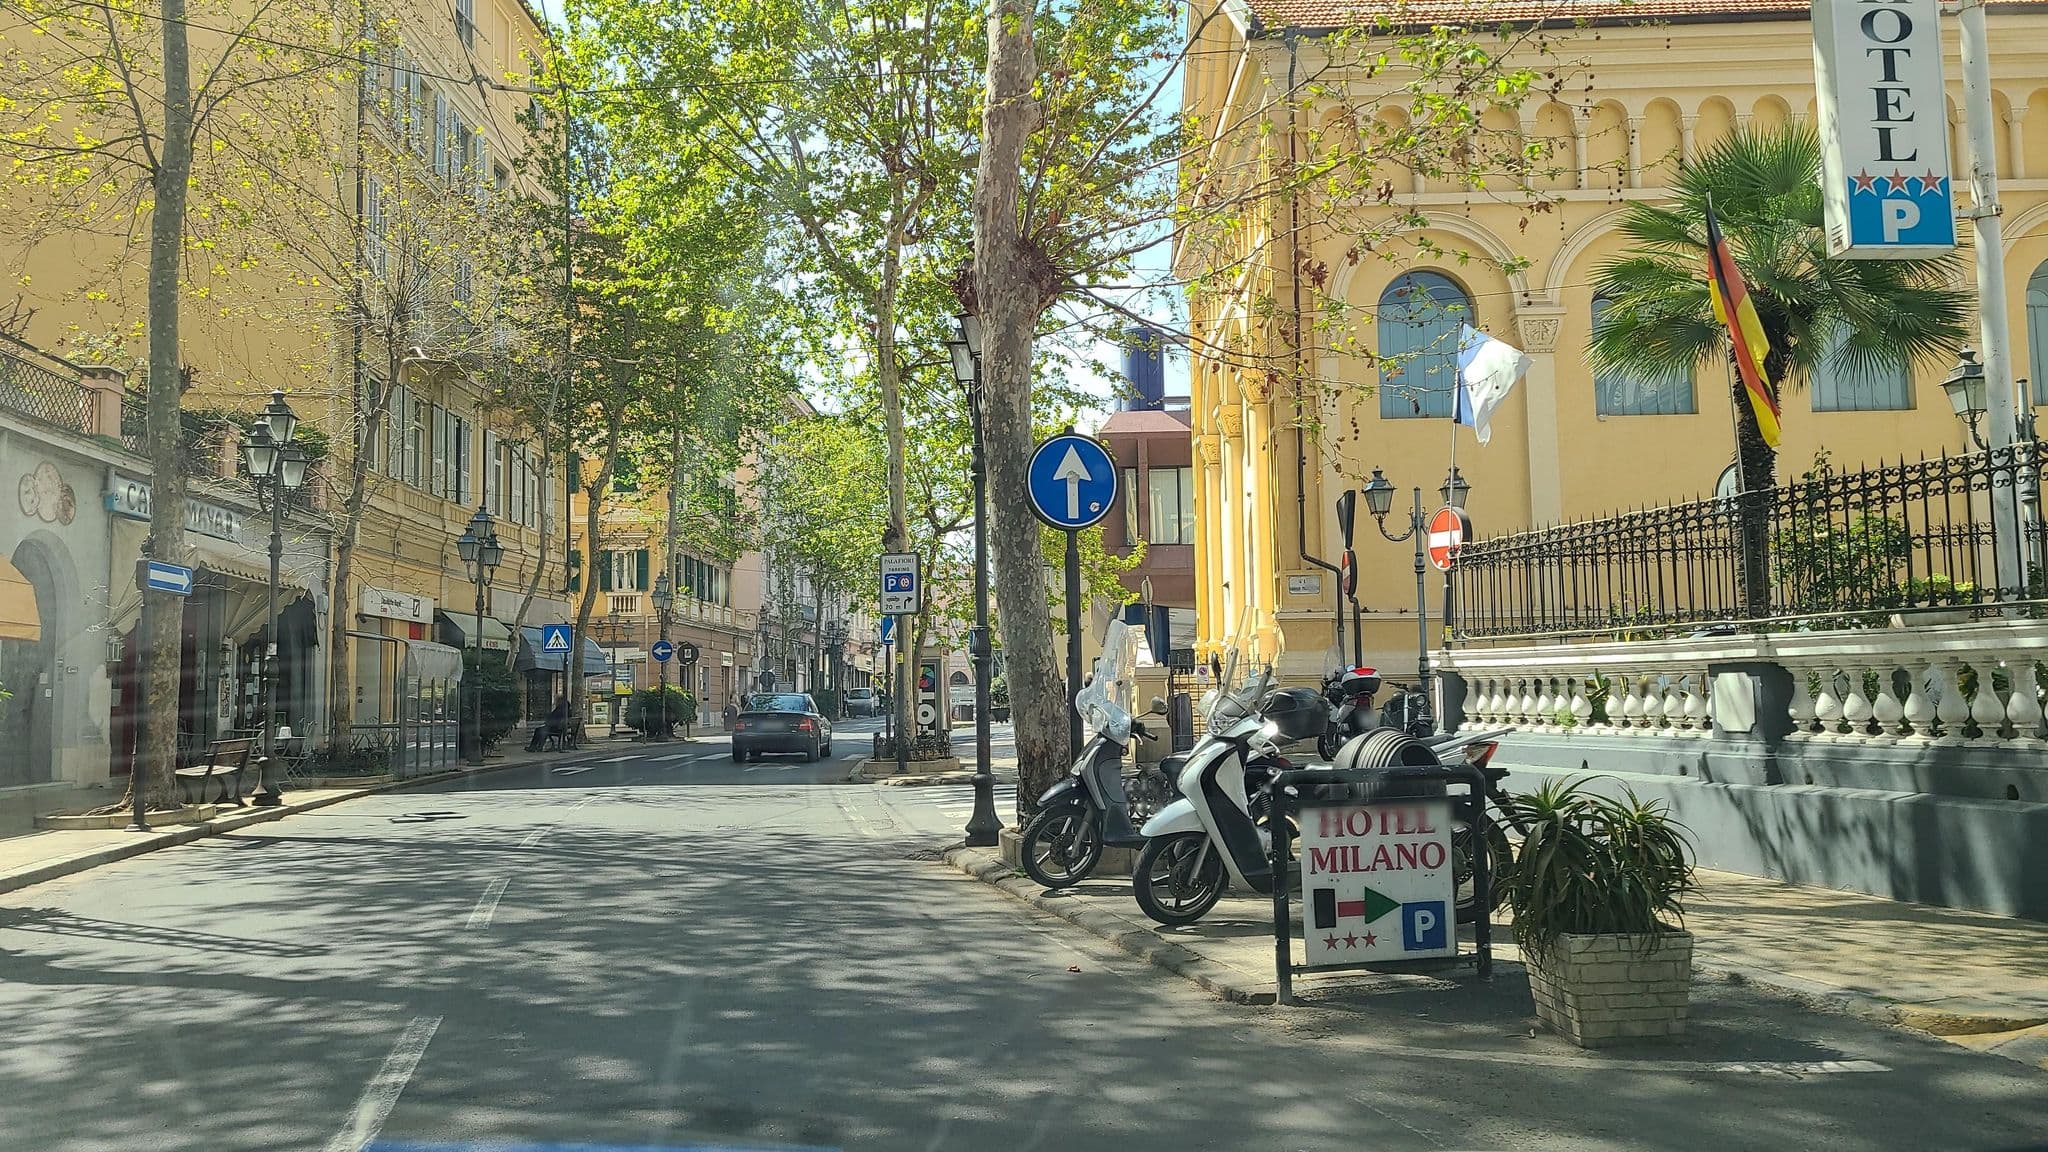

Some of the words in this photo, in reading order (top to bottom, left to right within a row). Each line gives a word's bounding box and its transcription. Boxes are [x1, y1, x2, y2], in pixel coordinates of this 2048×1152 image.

[1857, 0, 1917, 162] OTEL
[1881, 198, 1921, 243] P
[888, 578, 897, 591] P
[1309, 841, 1446, 875] MILANO
[1414, 909, 1436, 943] P
